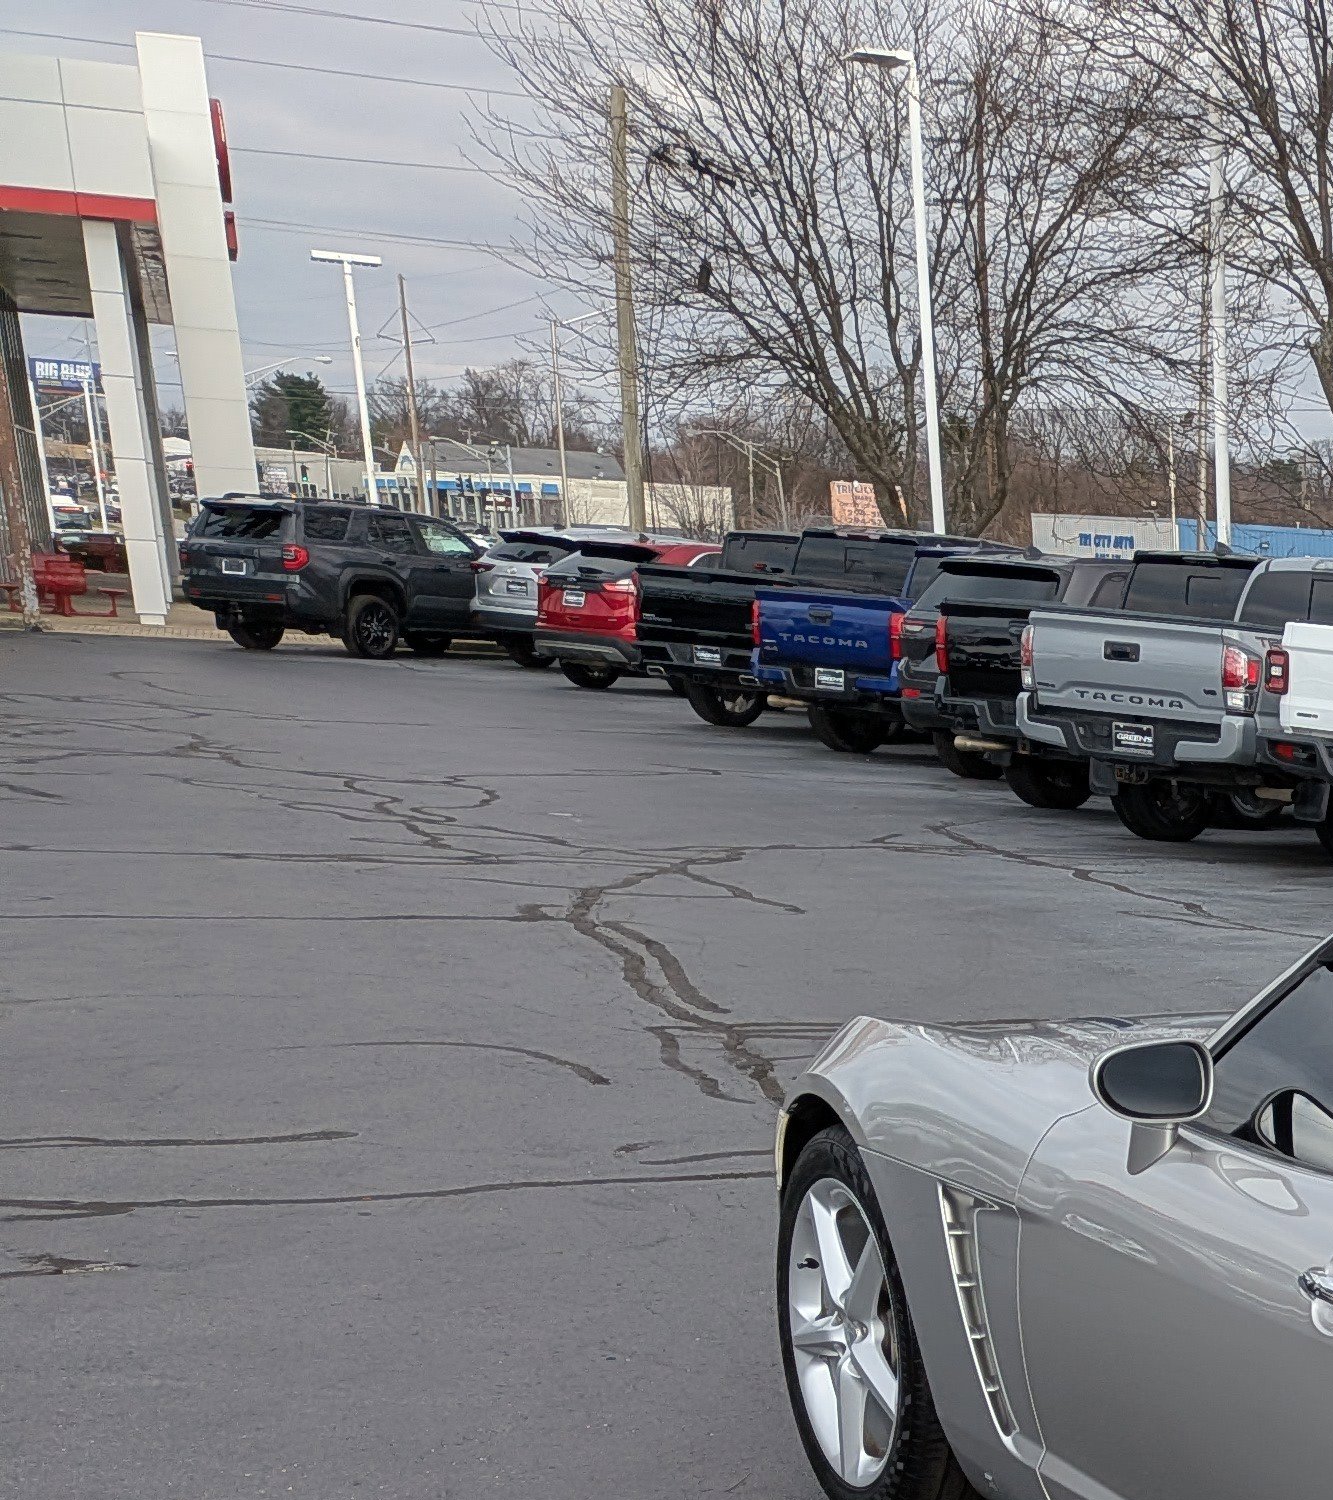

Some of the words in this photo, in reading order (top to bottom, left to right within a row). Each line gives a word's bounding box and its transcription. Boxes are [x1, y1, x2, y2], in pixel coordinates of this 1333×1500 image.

[1094, 534, 1112, 549] CITY
[778, 632, 869, 649] TACOMA
[1074, 689, 1184, 710] TACOMA
